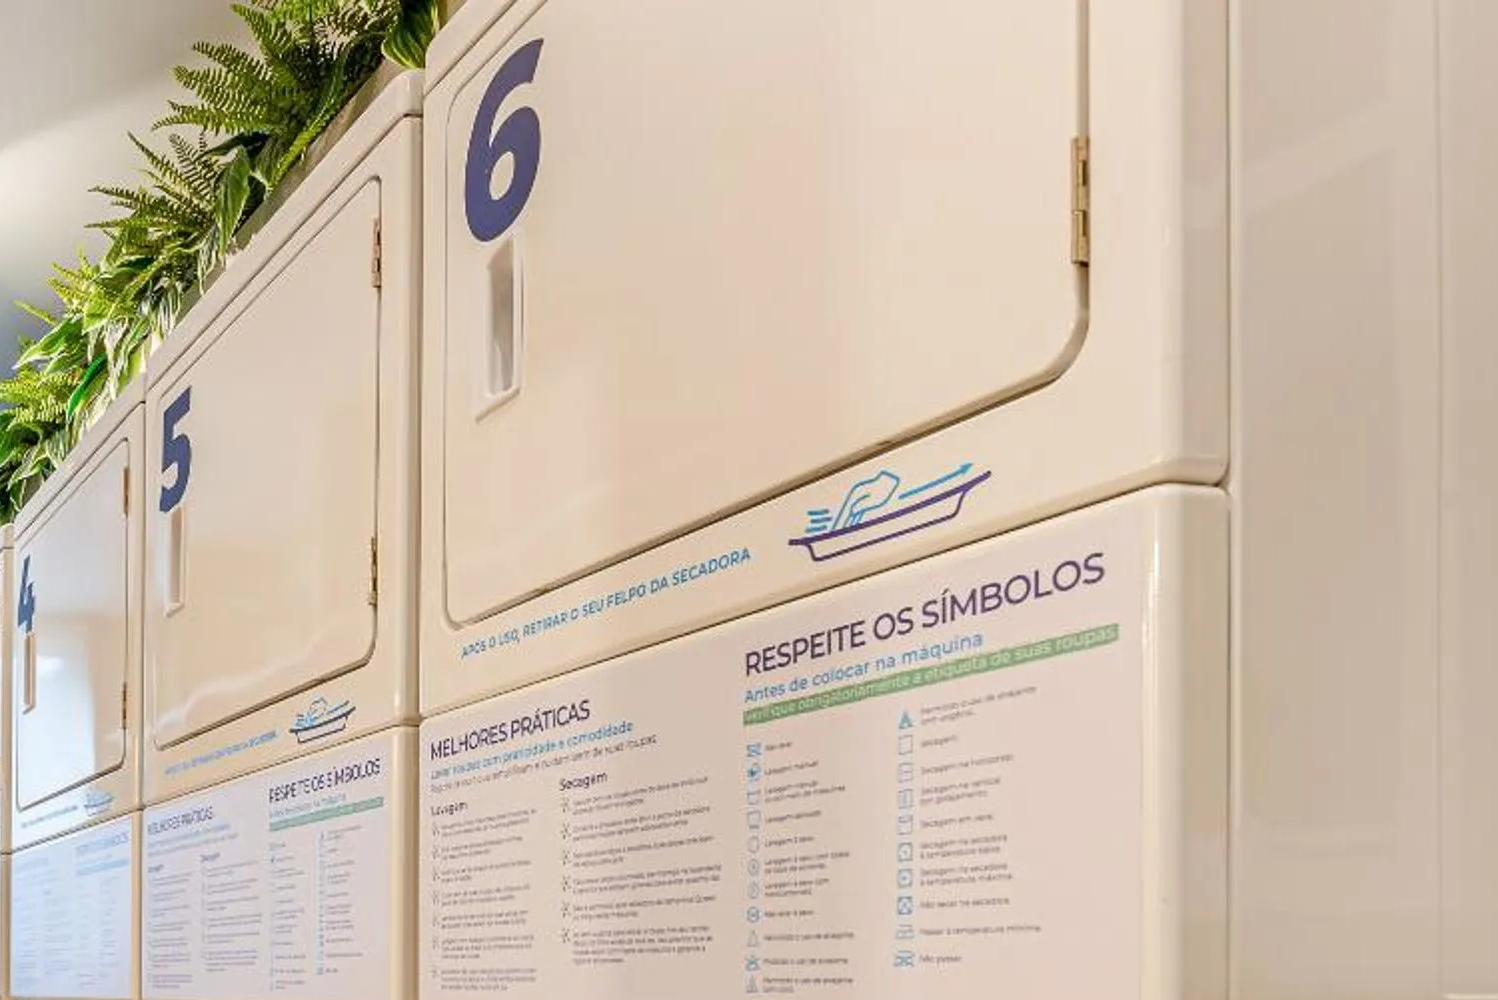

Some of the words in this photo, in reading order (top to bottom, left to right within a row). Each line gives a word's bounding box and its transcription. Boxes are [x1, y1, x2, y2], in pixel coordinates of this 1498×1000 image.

[464, 37, 545, 243] 6
[159, 387, 192, 513] 5
[17, 554, 35, 633] 4
[522, 612, 568, 638] RETIRAR
[582, 598, 605, 618] SEU
[607, 583, 647, 609] FELPO
[650, 576, 670, 595] DA
[672, 547, 751, 587] SECADORA
[745, 619, 866, 677] RESPEITE
[873, 607, 914, 641] OS
[922, 552, 1106, 629] SÍMBOLOS
[744, 680, 786, 704] Antes
[789, 674, 808, 693] de
[812, 659, 870, 688] colocar
[875, 654, 896, 672] na
[902, 632, 984, 664] máquina
[431, 722, 508, 760] MELHORES
[510, 699, 591, 740] PRÁTICAS
